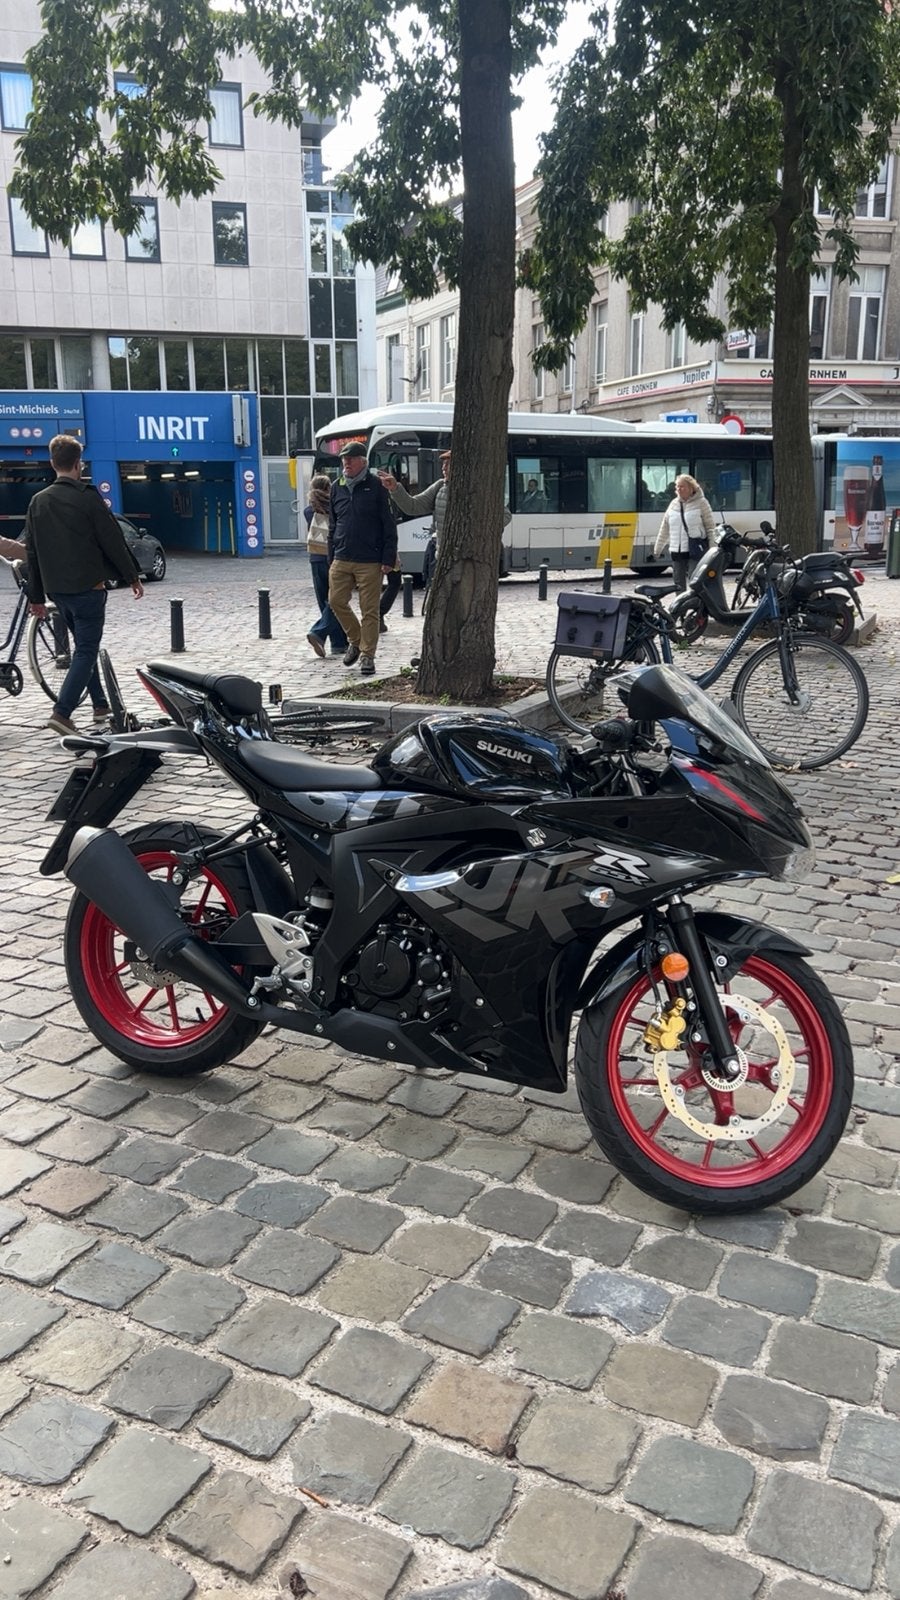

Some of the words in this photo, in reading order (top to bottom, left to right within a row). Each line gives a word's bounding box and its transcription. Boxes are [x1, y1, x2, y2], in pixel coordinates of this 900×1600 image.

[682, 369, 710, 385] Jupiler
[760, 369, 774, 378] CA
[810, 370, 847, 379] RNHEM
[138, 416, 209, 440] INRIT
[476, 739, 534, 765] SUZUKI
